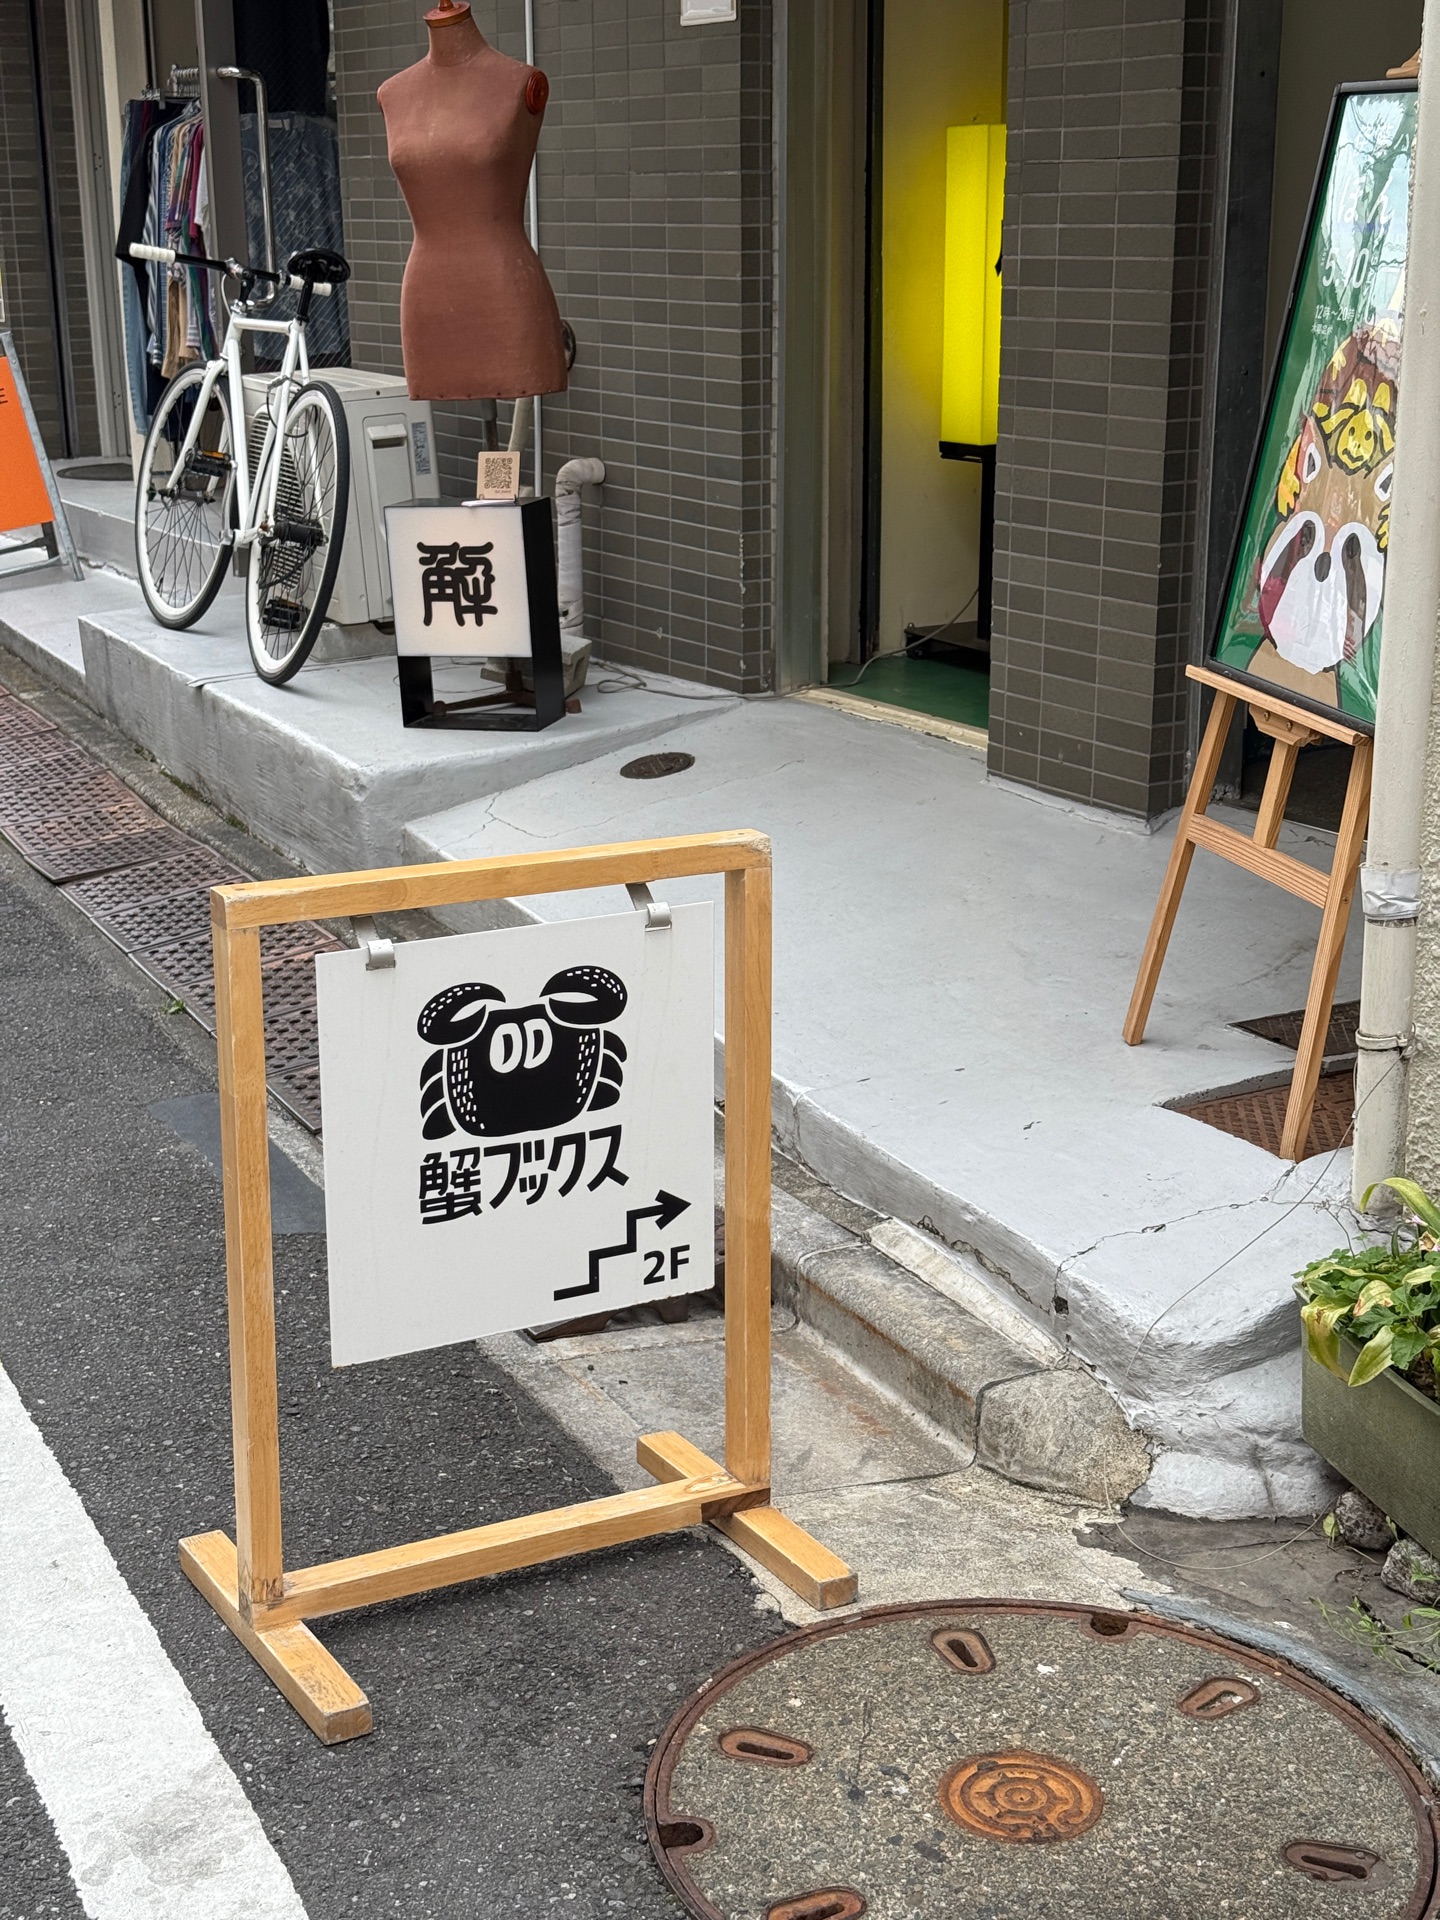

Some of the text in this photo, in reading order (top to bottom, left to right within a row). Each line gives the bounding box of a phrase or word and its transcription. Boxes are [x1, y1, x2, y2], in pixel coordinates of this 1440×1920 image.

[1322, 247, 1370, 289] 5.10
[418, 1124, 630, 1225] 蟹ブックス
[643, 1244, 690, 1286] 2F
